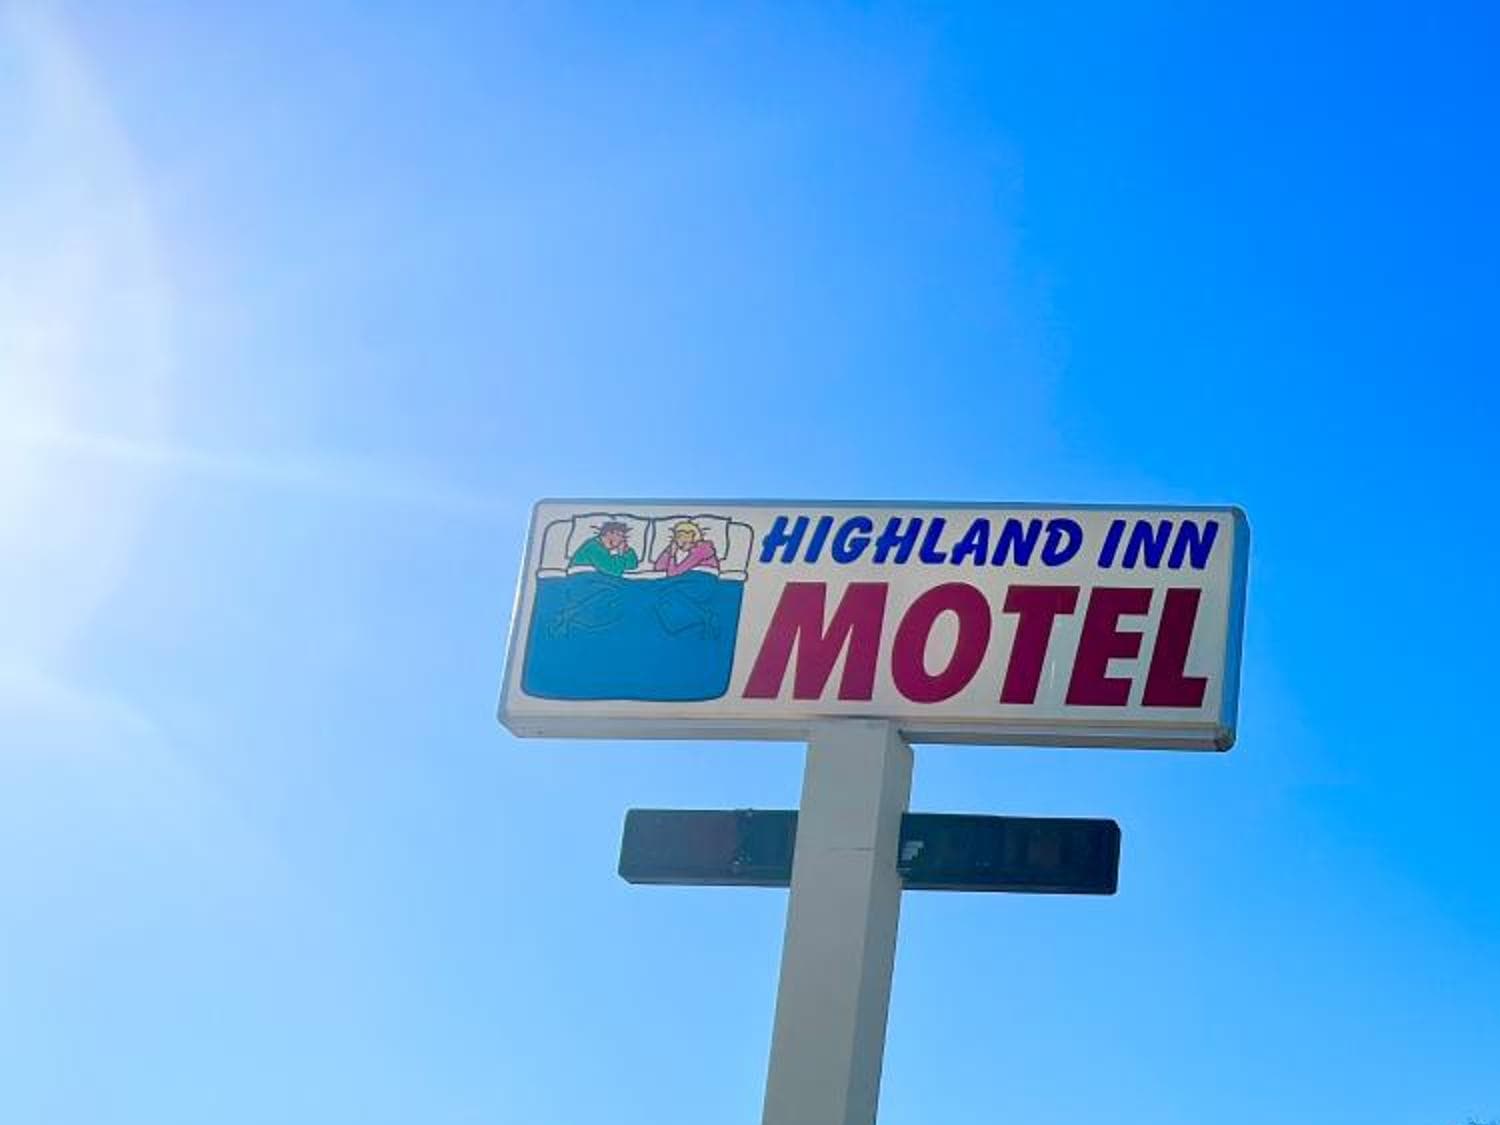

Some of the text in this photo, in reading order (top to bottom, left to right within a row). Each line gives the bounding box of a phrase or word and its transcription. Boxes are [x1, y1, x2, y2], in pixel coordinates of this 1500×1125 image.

[759, 515, 1219, 570] HIGHLAND INN
[742, 581, 1208, 708] MOTEL
